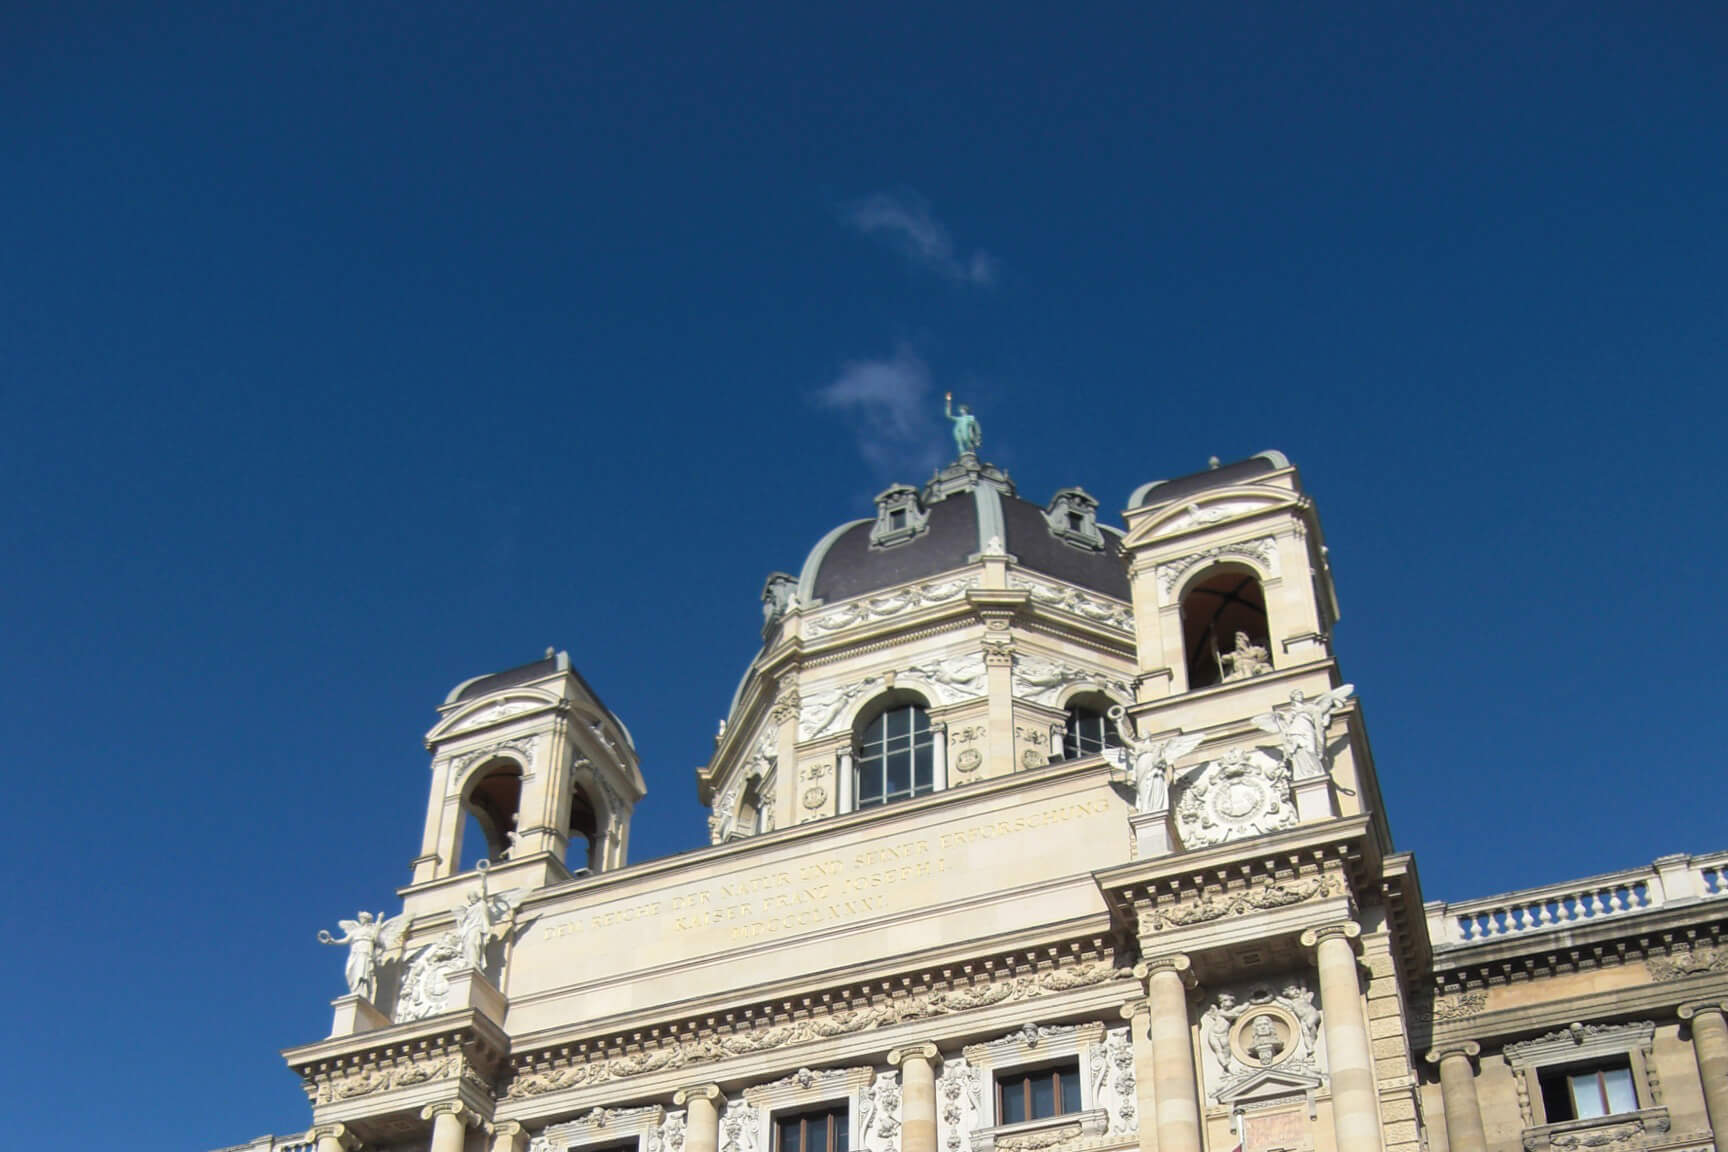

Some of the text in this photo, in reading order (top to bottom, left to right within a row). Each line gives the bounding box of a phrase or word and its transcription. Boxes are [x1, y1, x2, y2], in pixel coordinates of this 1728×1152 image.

[542, 797, 1110, 941] DEM REICHE DER NATUR UND SEINER ERFORSCHUNG
[675, 903, 751, 932] KAISER
[761, 884, 829, 912] FRANZ
[841, 861, 932, 896] JOSEPH
